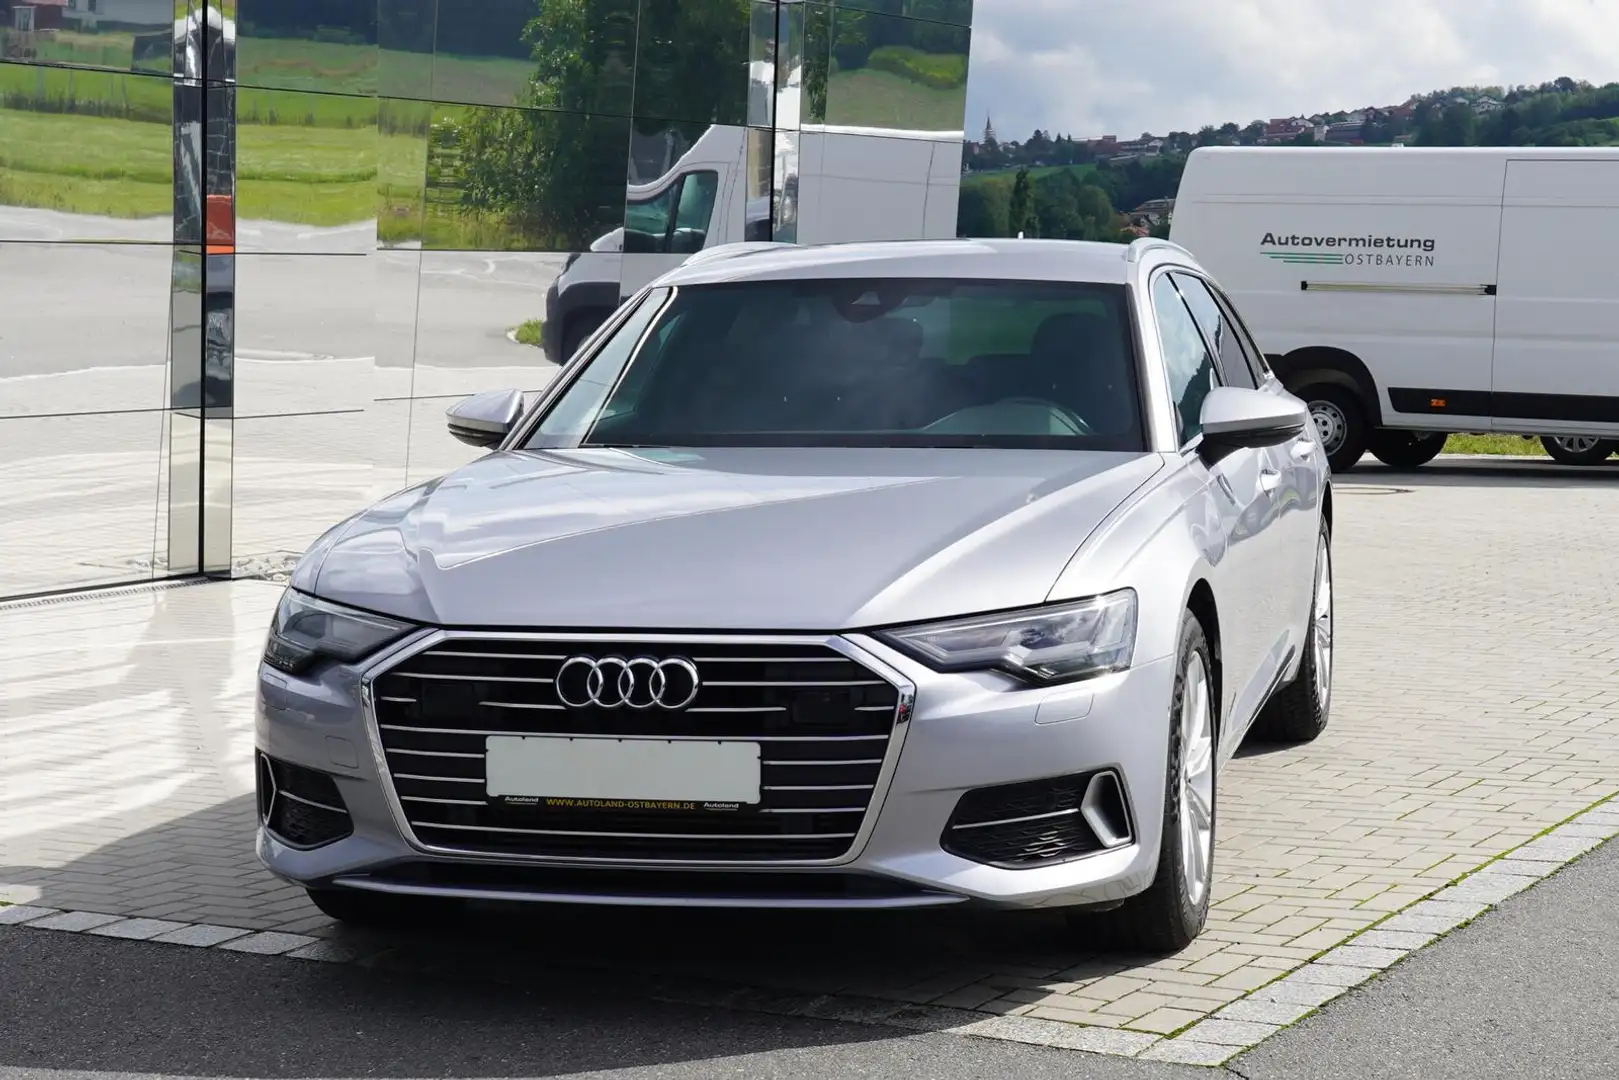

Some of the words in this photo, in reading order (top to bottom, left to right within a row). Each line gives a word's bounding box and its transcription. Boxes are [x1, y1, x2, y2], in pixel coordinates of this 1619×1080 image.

[1260, 232, 1435, 251] Autovermietung
[1344, 253, 1434, 267] OSTBAYERN
[504, 796, 539, 804] Autoland
[546, 798, 696, 810] WWW.AUTOLAND-OSTBAYERN.DE
[703, 801, 739, 809] Autoland
